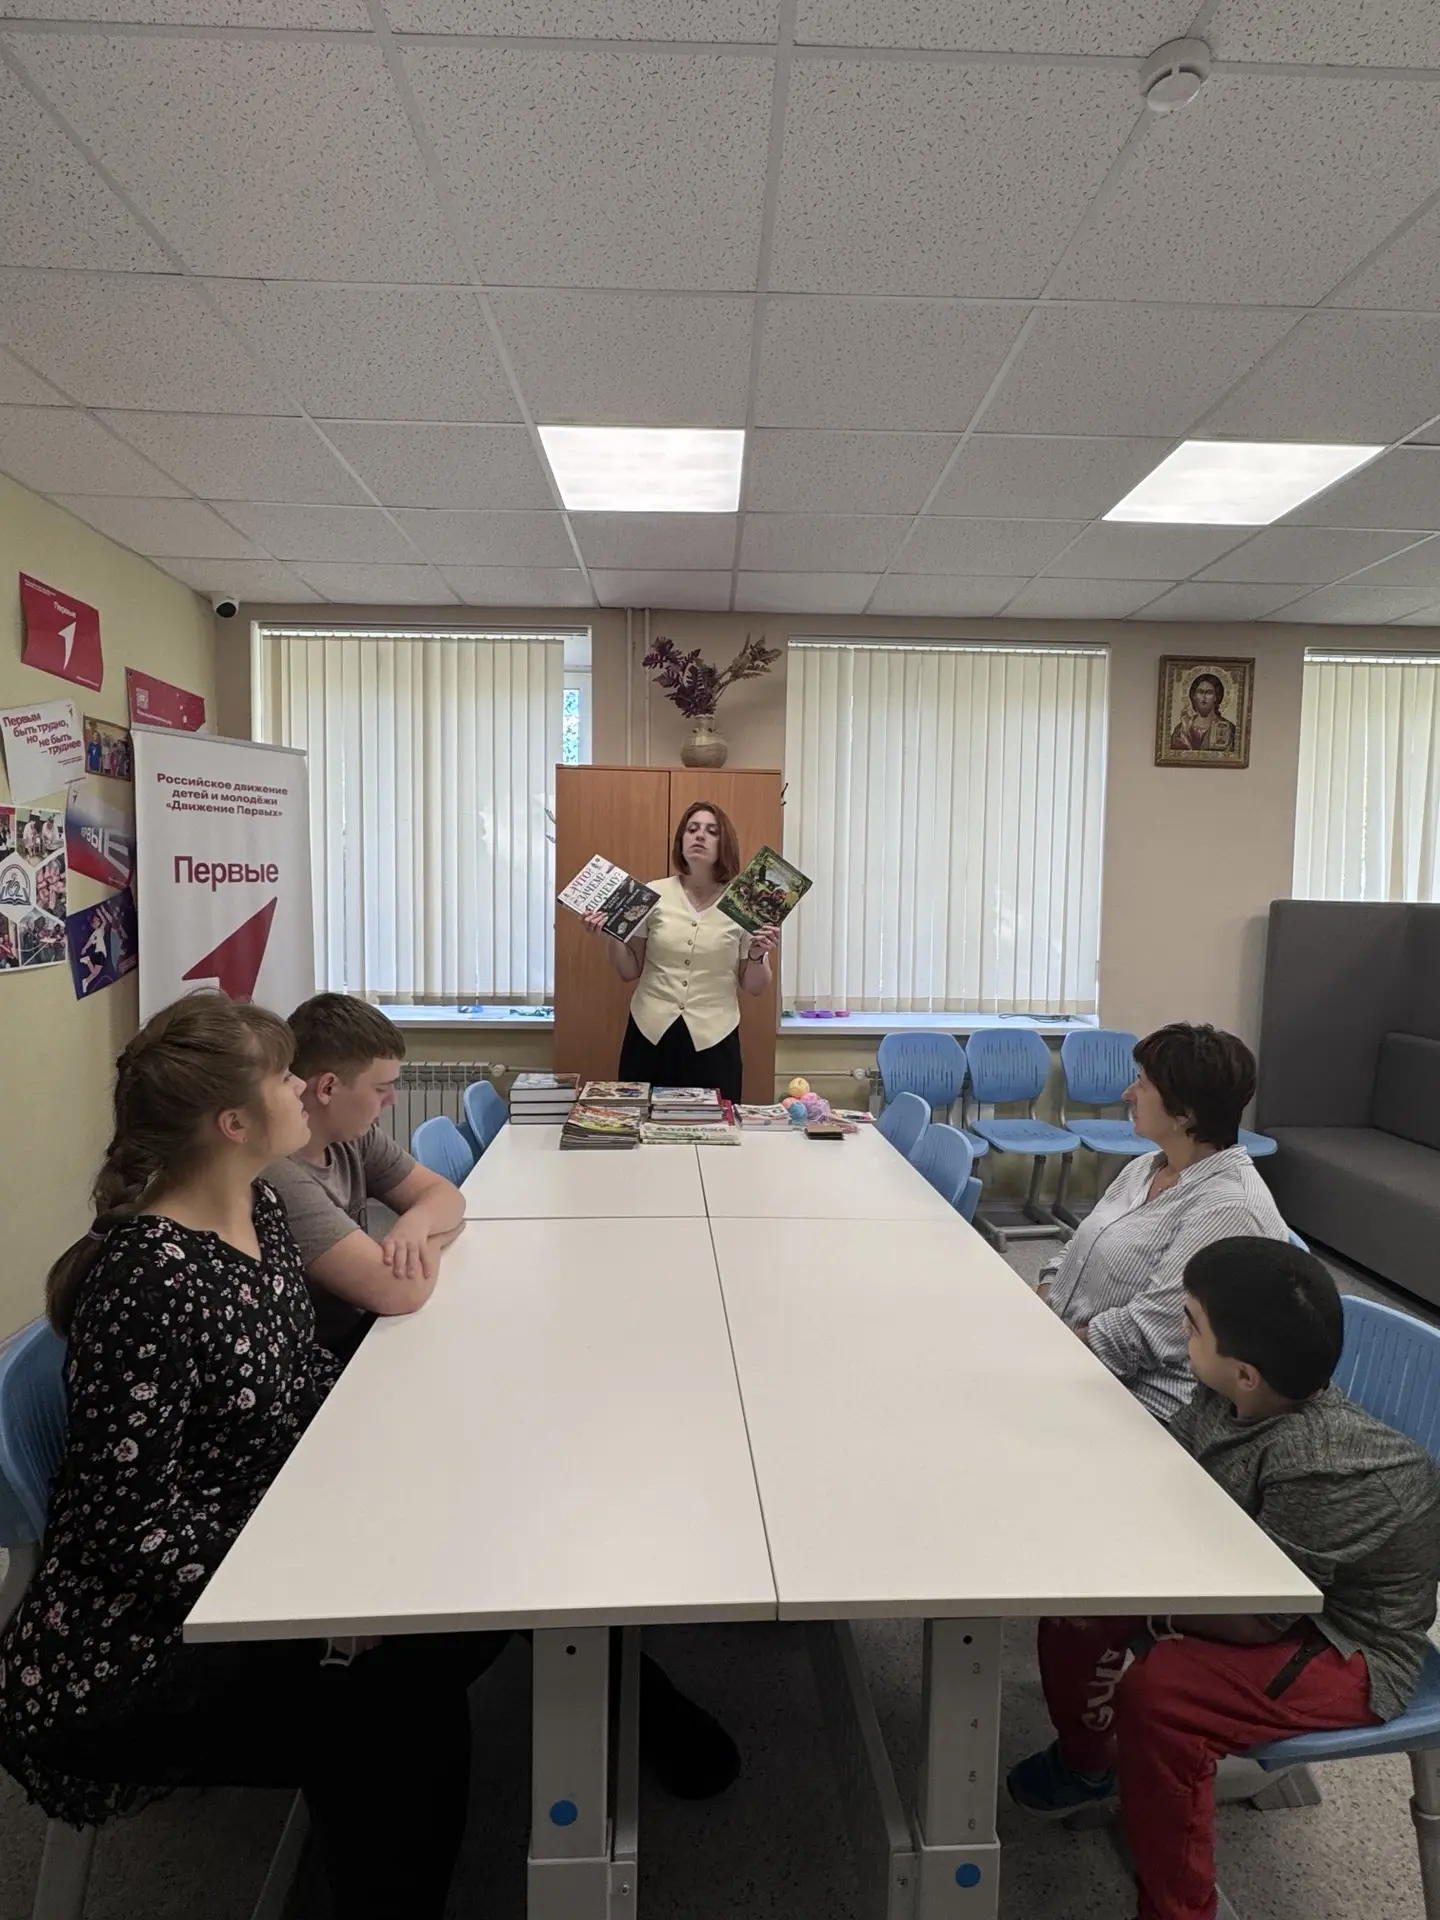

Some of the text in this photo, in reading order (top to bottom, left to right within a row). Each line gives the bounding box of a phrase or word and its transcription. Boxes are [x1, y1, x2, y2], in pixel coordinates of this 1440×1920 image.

[2, 713, 41, 728] Первым
[13, 720, 69, 738] быть трудно,
[26, 733, 72, 747] но не быть
[48, 740, 81, 755] труднее
[157, 773, 288, 796] Российское движение
[172, 789, 278, 805] детей и молодёжи
[166, 800, 283, 817] «Движение Первых»
[174, 855, 279, 892] Первые
[572, 867, 594, 889] ЧТО?
[579, 872, 606, 903] ЗАЧЕМ?
[588, 872, 623, 910] ПОЧЕМУ?
[972, 1662, 981, 1675] 3
[970, 1718, 979, 1730] 4
[967, 1769, 977, 1783] 5
[967, 1818, 976, 1831] 6
